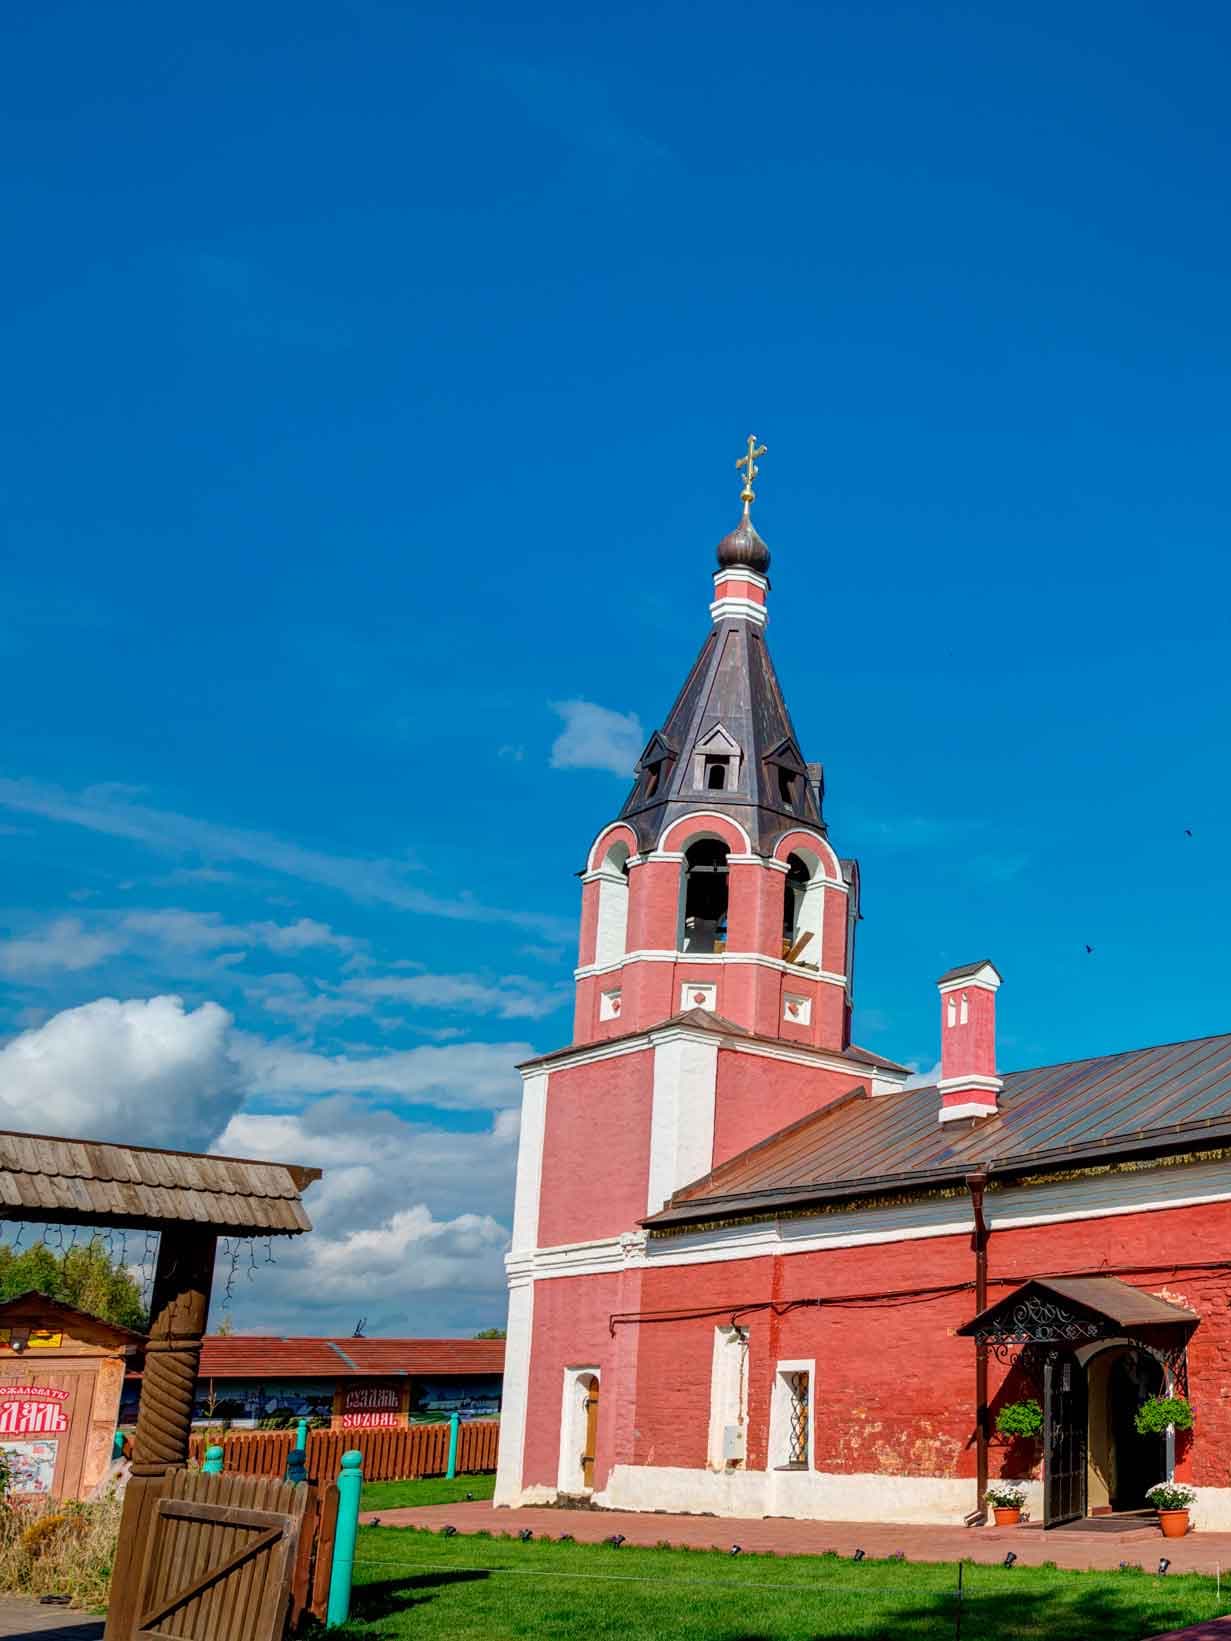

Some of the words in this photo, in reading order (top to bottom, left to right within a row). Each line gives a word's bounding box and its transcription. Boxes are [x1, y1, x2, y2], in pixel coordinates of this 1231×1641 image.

[0, 1387, 69, 1400] ОЖАЛОВАТЬ!
[0, 1402, 67, 1434] ДАЛЬ
[343, 1412, 397, 1427] SUZDAL
